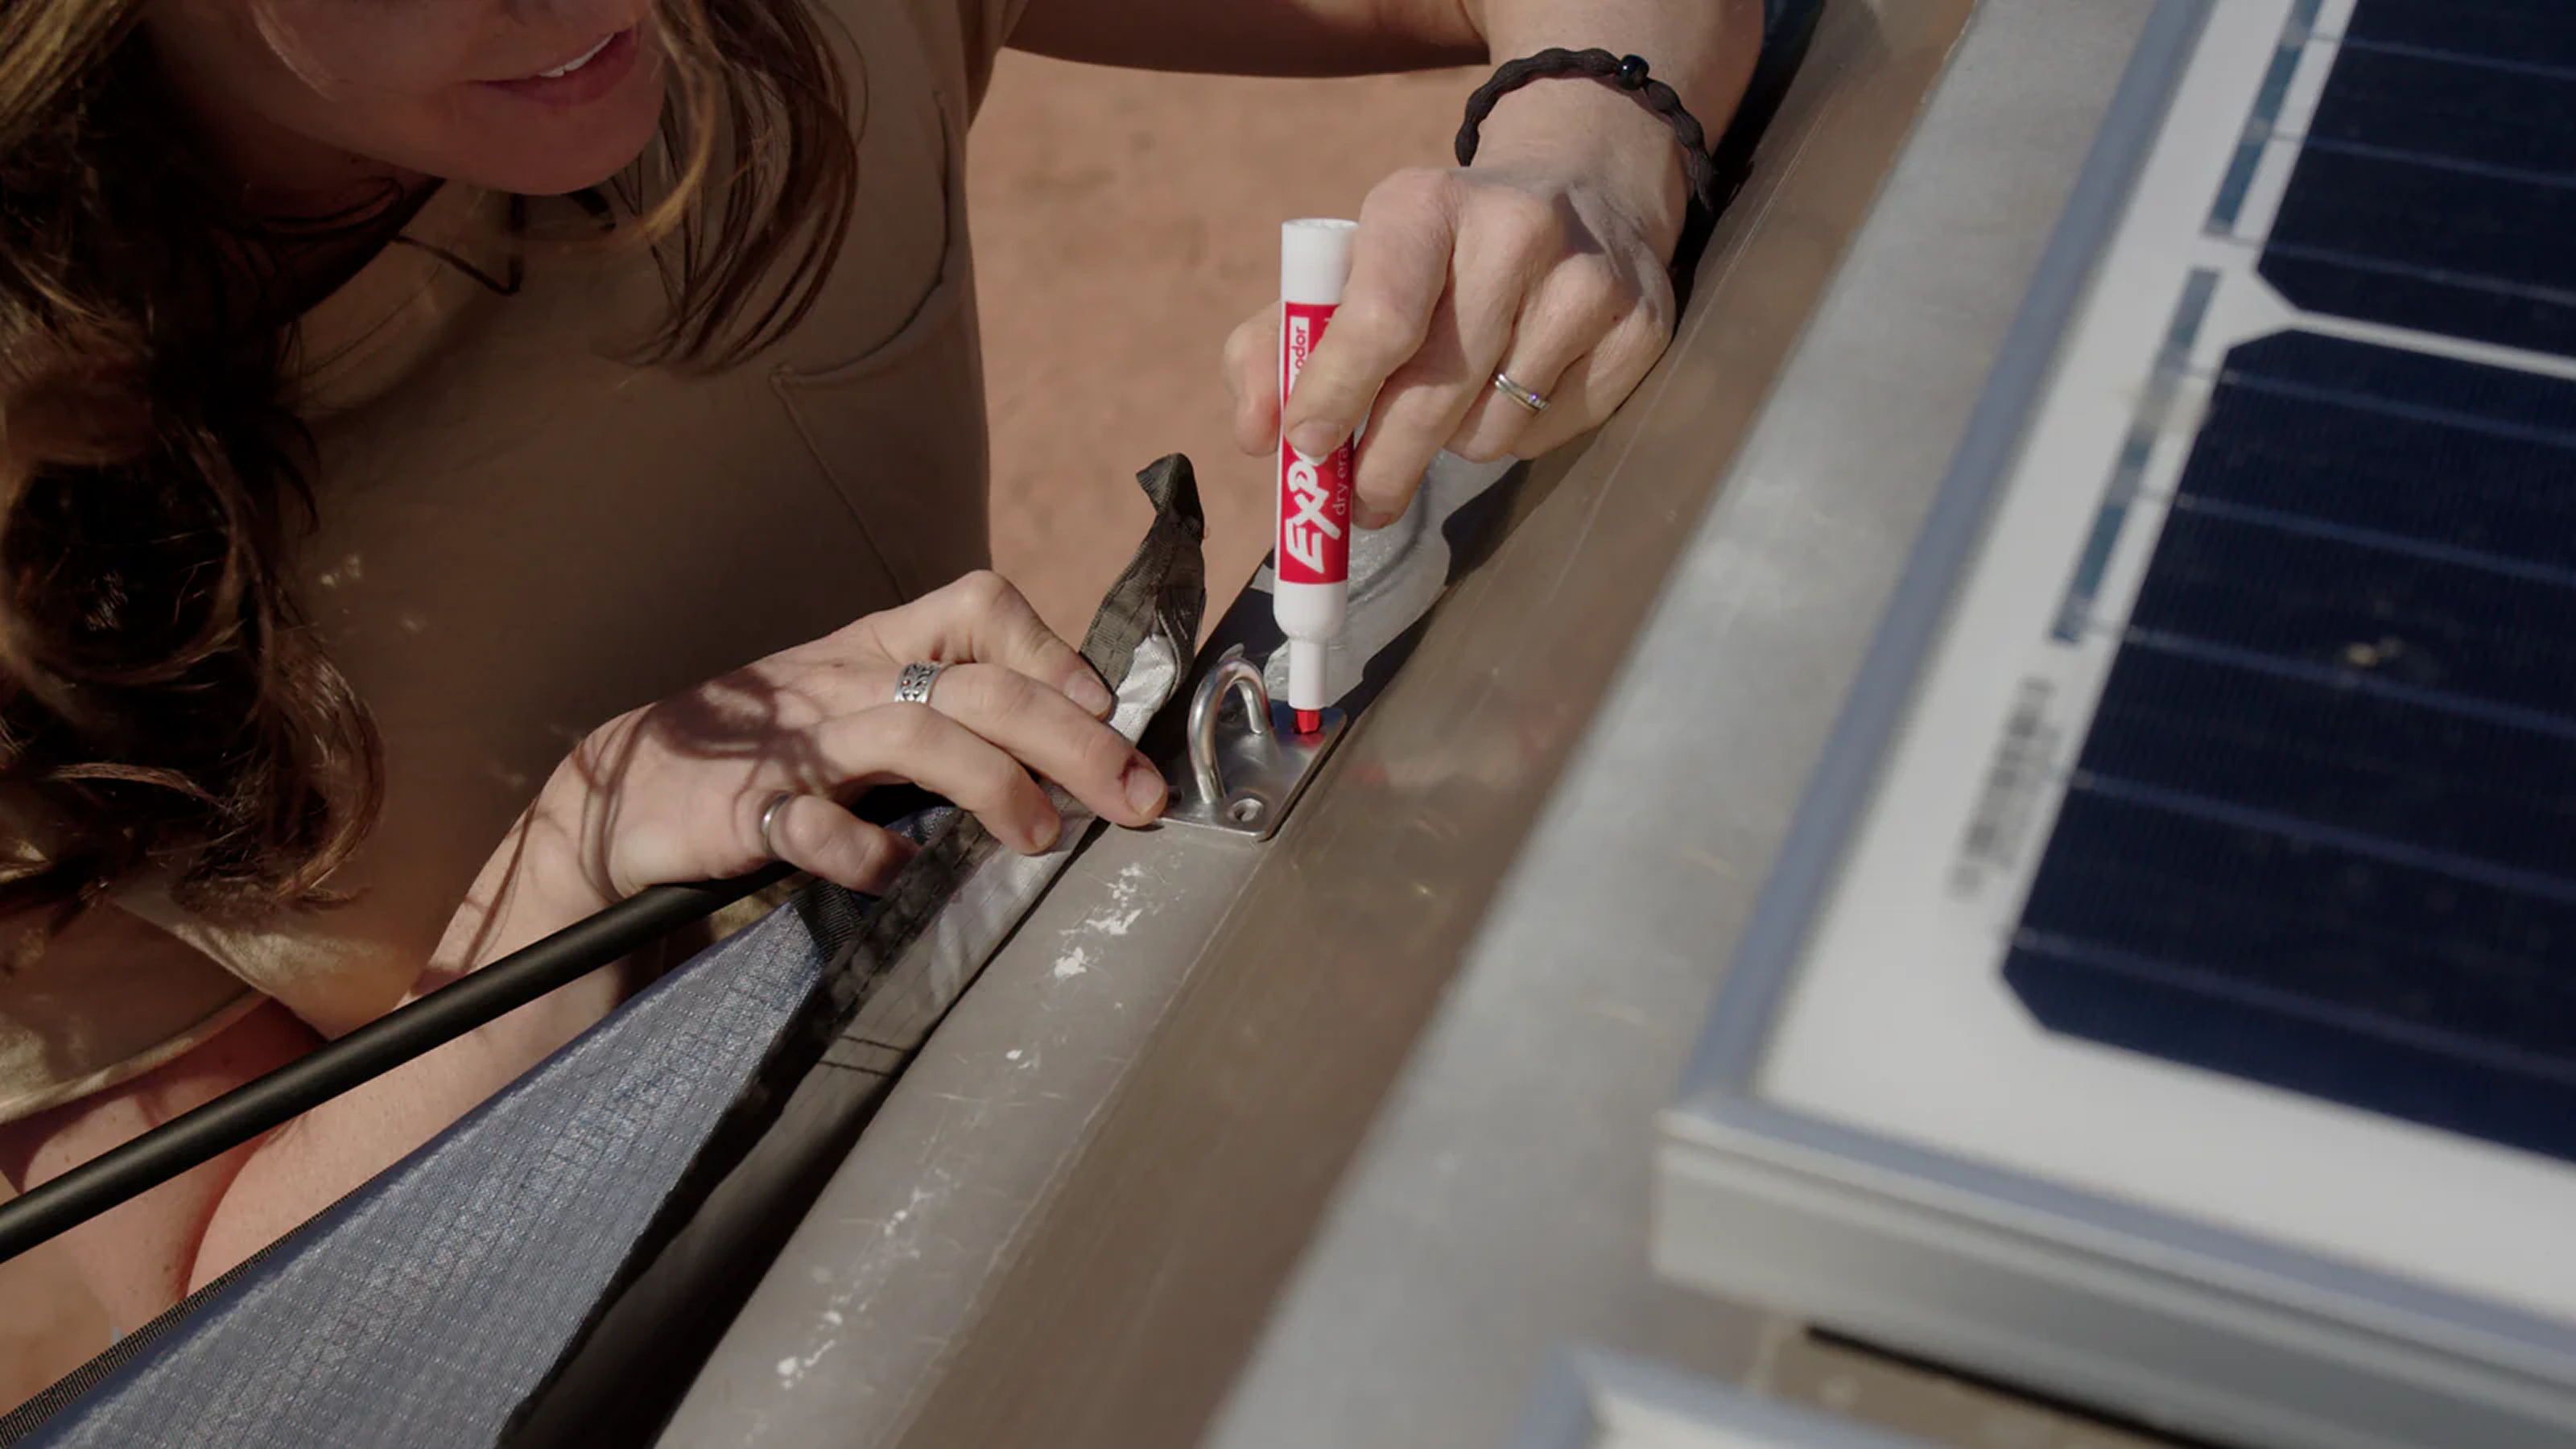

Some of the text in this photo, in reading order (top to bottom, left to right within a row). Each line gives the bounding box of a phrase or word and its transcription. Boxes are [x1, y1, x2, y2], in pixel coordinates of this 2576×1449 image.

[1292, 326, 1306, 369] odor
[1332, 444, 1349, 515] dry era
